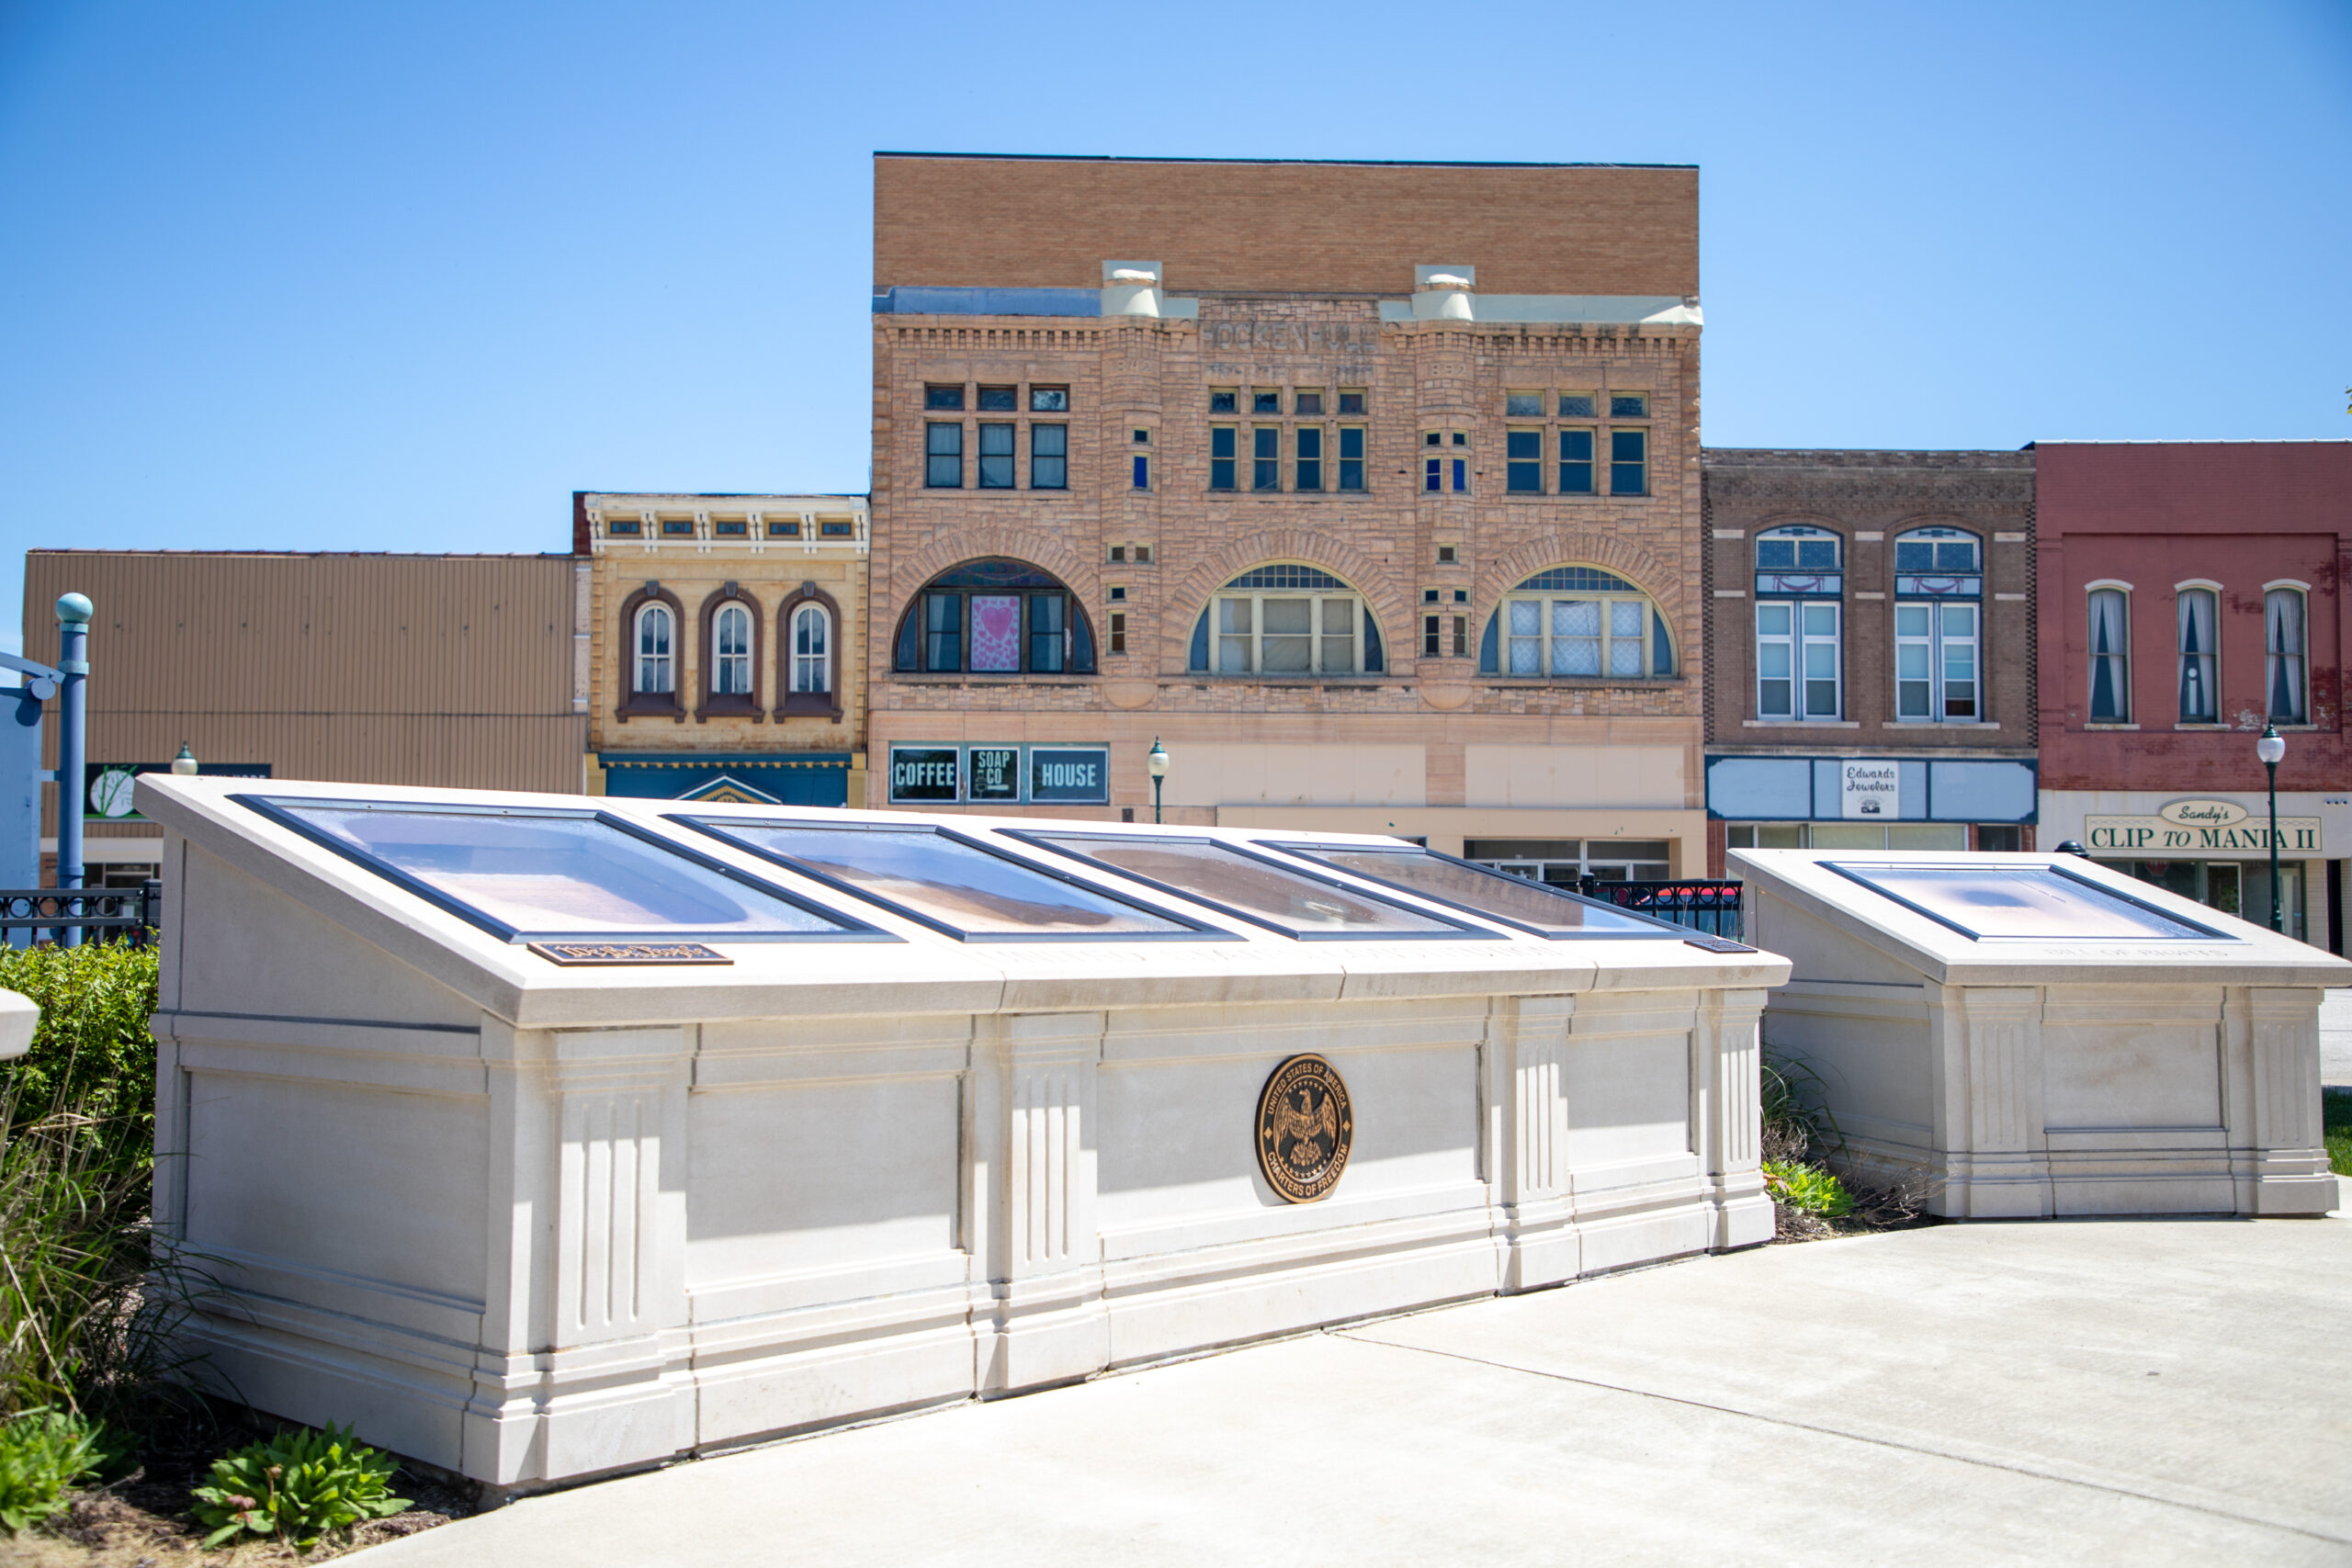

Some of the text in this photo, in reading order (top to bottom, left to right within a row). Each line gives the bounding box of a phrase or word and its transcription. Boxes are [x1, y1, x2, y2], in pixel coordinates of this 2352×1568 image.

[978, 750, 1010, 768] SOAP
[895, 762, 955, 786] COFFEE
[987, 768, 1002, 784] CO
[1042, 763, 1096, 787] HOUSE
[1847, 766, 1895, 779] Edwards
[1846, 780, 1895, 792] Jewelers
[2178, 806, 2230, 824] Sandy's
[2090, 827, 2315, 849] CLIP TO MANIA II
[1267, 1063, 1348, 1115] UNITED STATES OF AMERICA
[1267, 1143, 1349, 1196] CHARTERS OF FREEDOM
